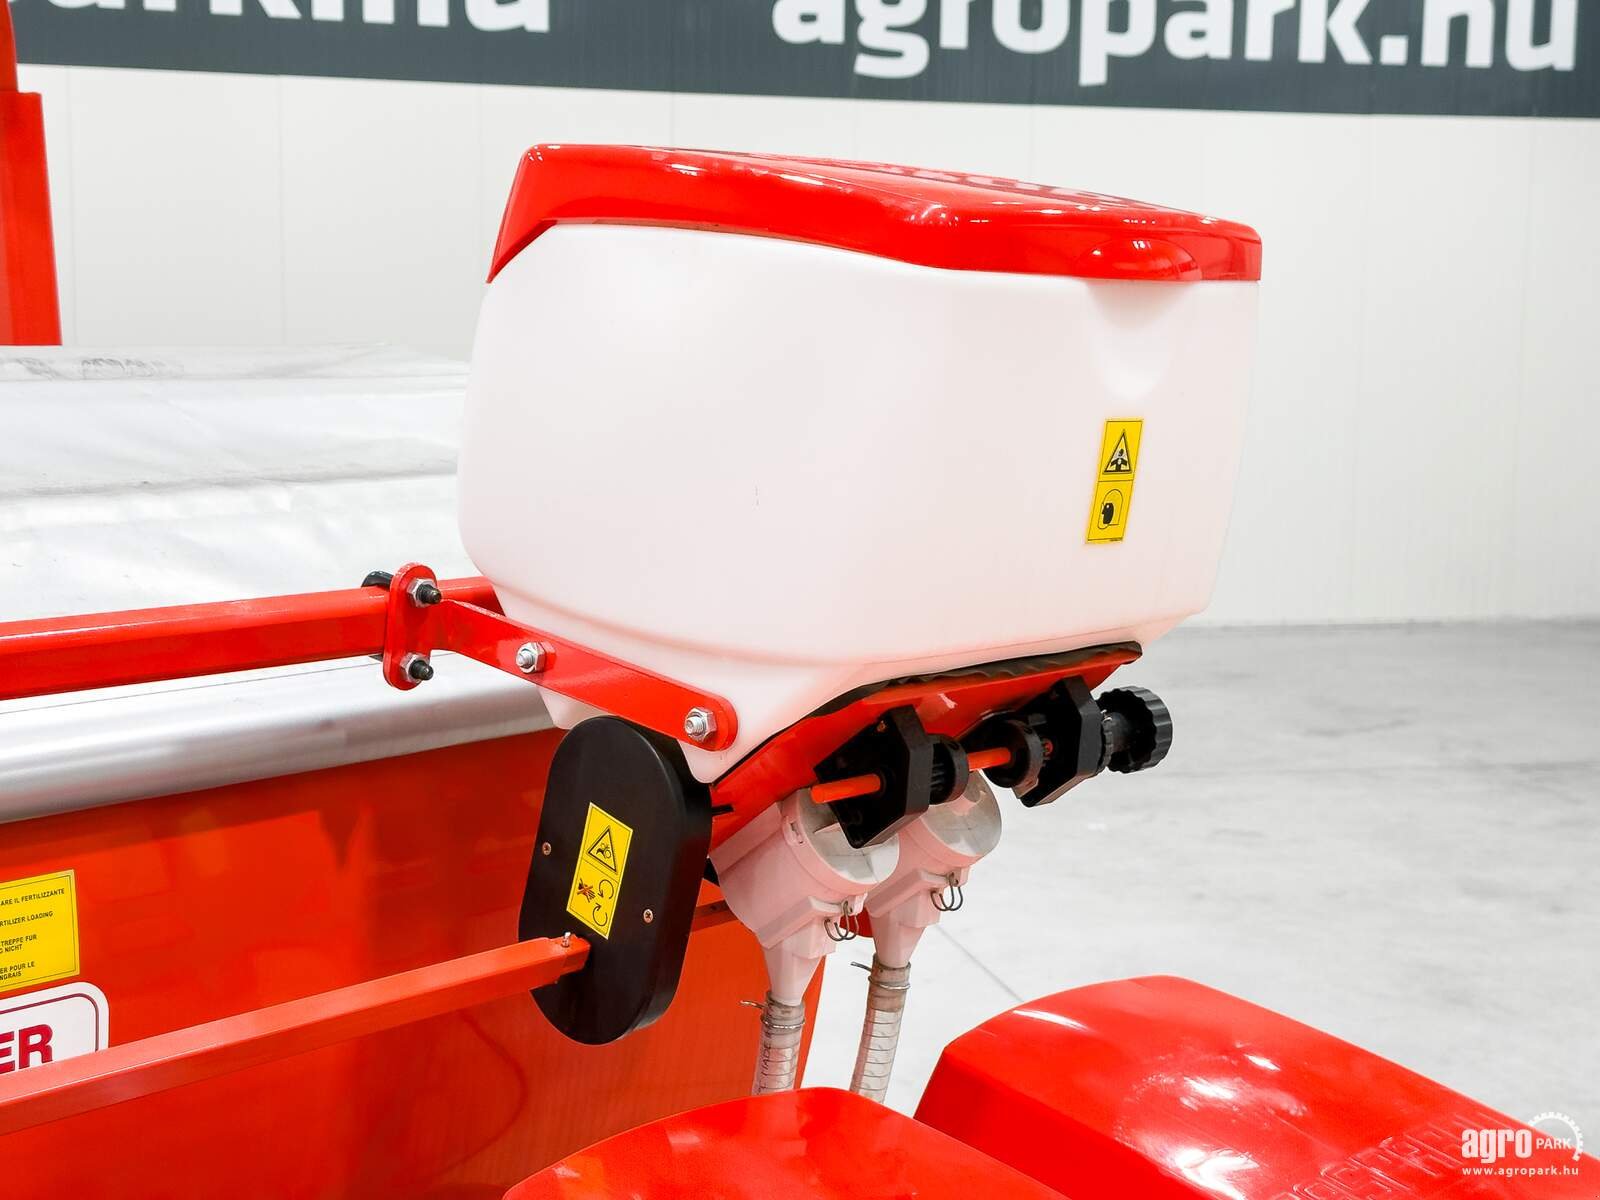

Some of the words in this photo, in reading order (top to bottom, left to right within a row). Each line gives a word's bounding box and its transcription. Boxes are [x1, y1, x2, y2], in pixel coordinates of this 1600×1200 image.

[21, 888, 64, 902] FERTILIZZANTE
[27, 911, 53, 921] LOADING
[10, 963, 25, 971] POUR
